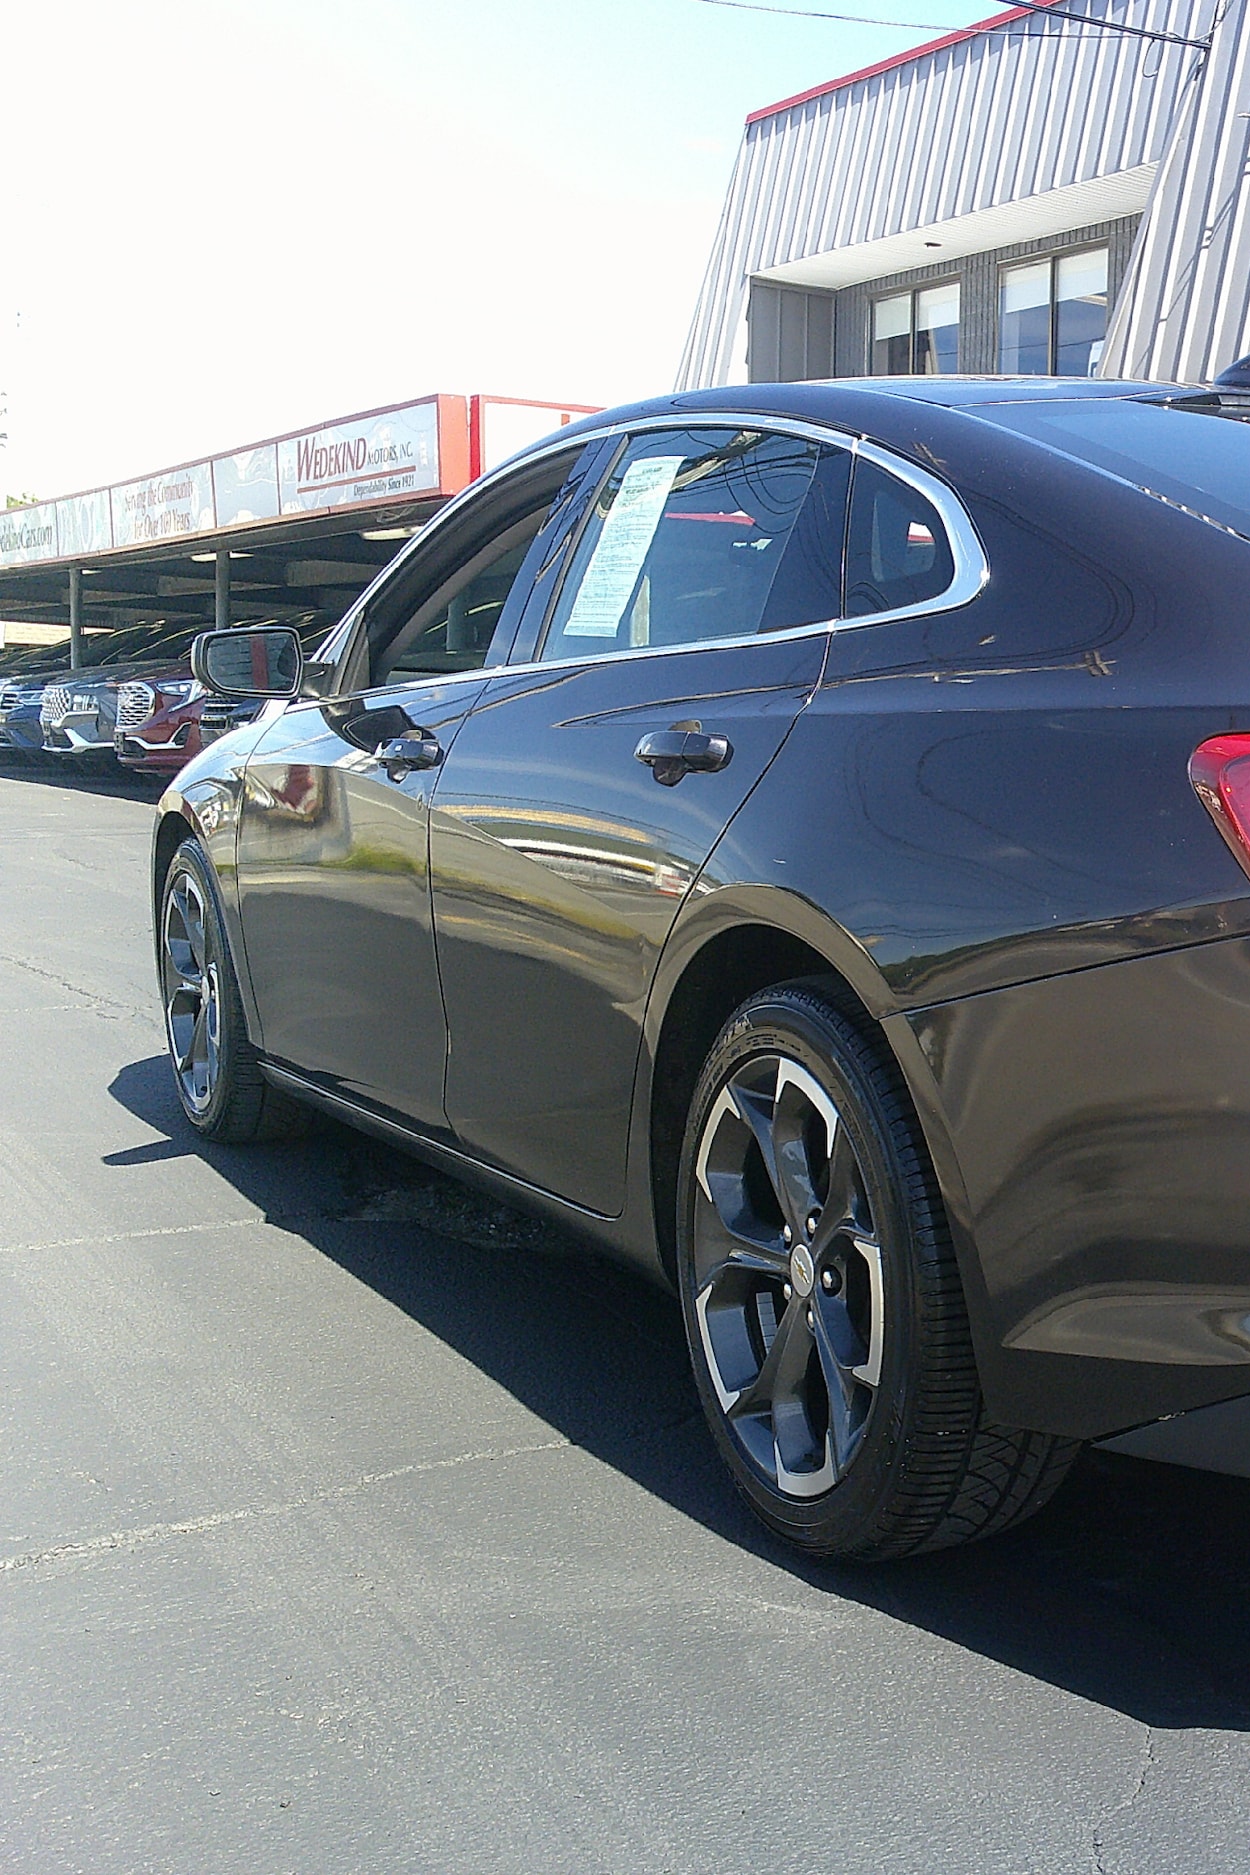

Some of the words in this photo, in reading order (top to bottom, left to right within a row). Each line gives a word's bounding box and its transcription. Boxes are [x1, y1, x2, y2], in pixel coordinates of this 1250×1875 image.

[297, 437, 367, 482] WEDEKIND
[388, 477, 401, 491] Since
[402, 474, 415, 488] 1921
